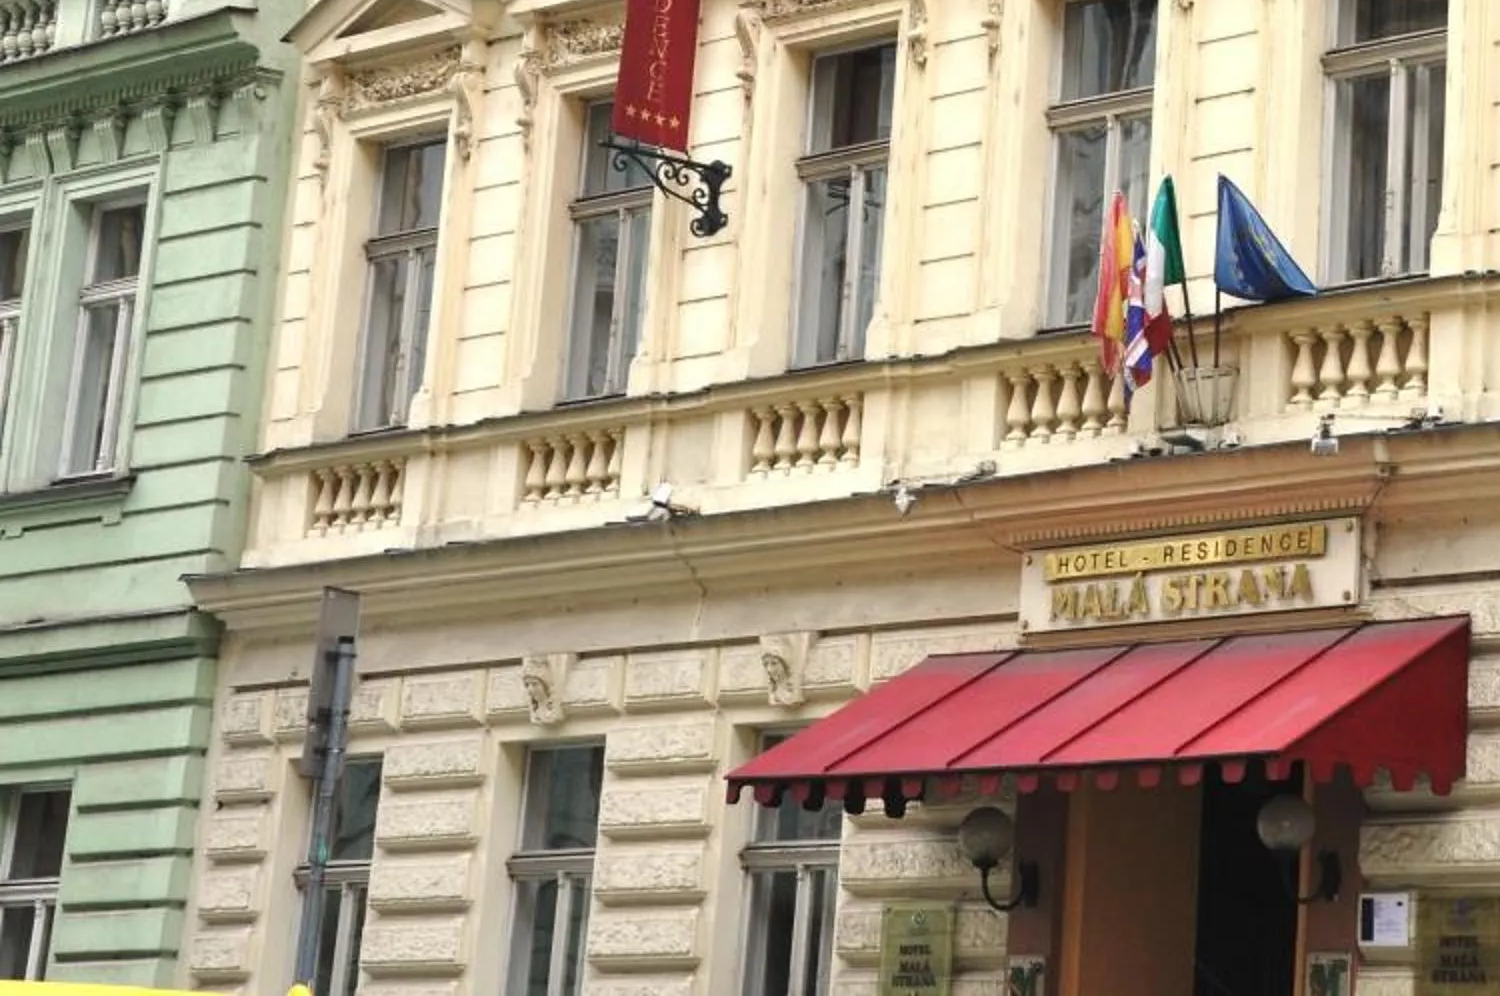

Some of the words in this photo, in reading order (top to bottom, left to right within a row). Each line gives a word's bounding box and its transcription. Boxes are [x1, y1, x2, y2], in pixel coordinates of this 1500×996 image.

[1057, 551, 1129, 574] HOTEL
[1162, 529, 1310, 563] RESIDENCE
[1050, 569, 1150, 622] MALÁ
[1160, 562, 1315, 613] STRANA
